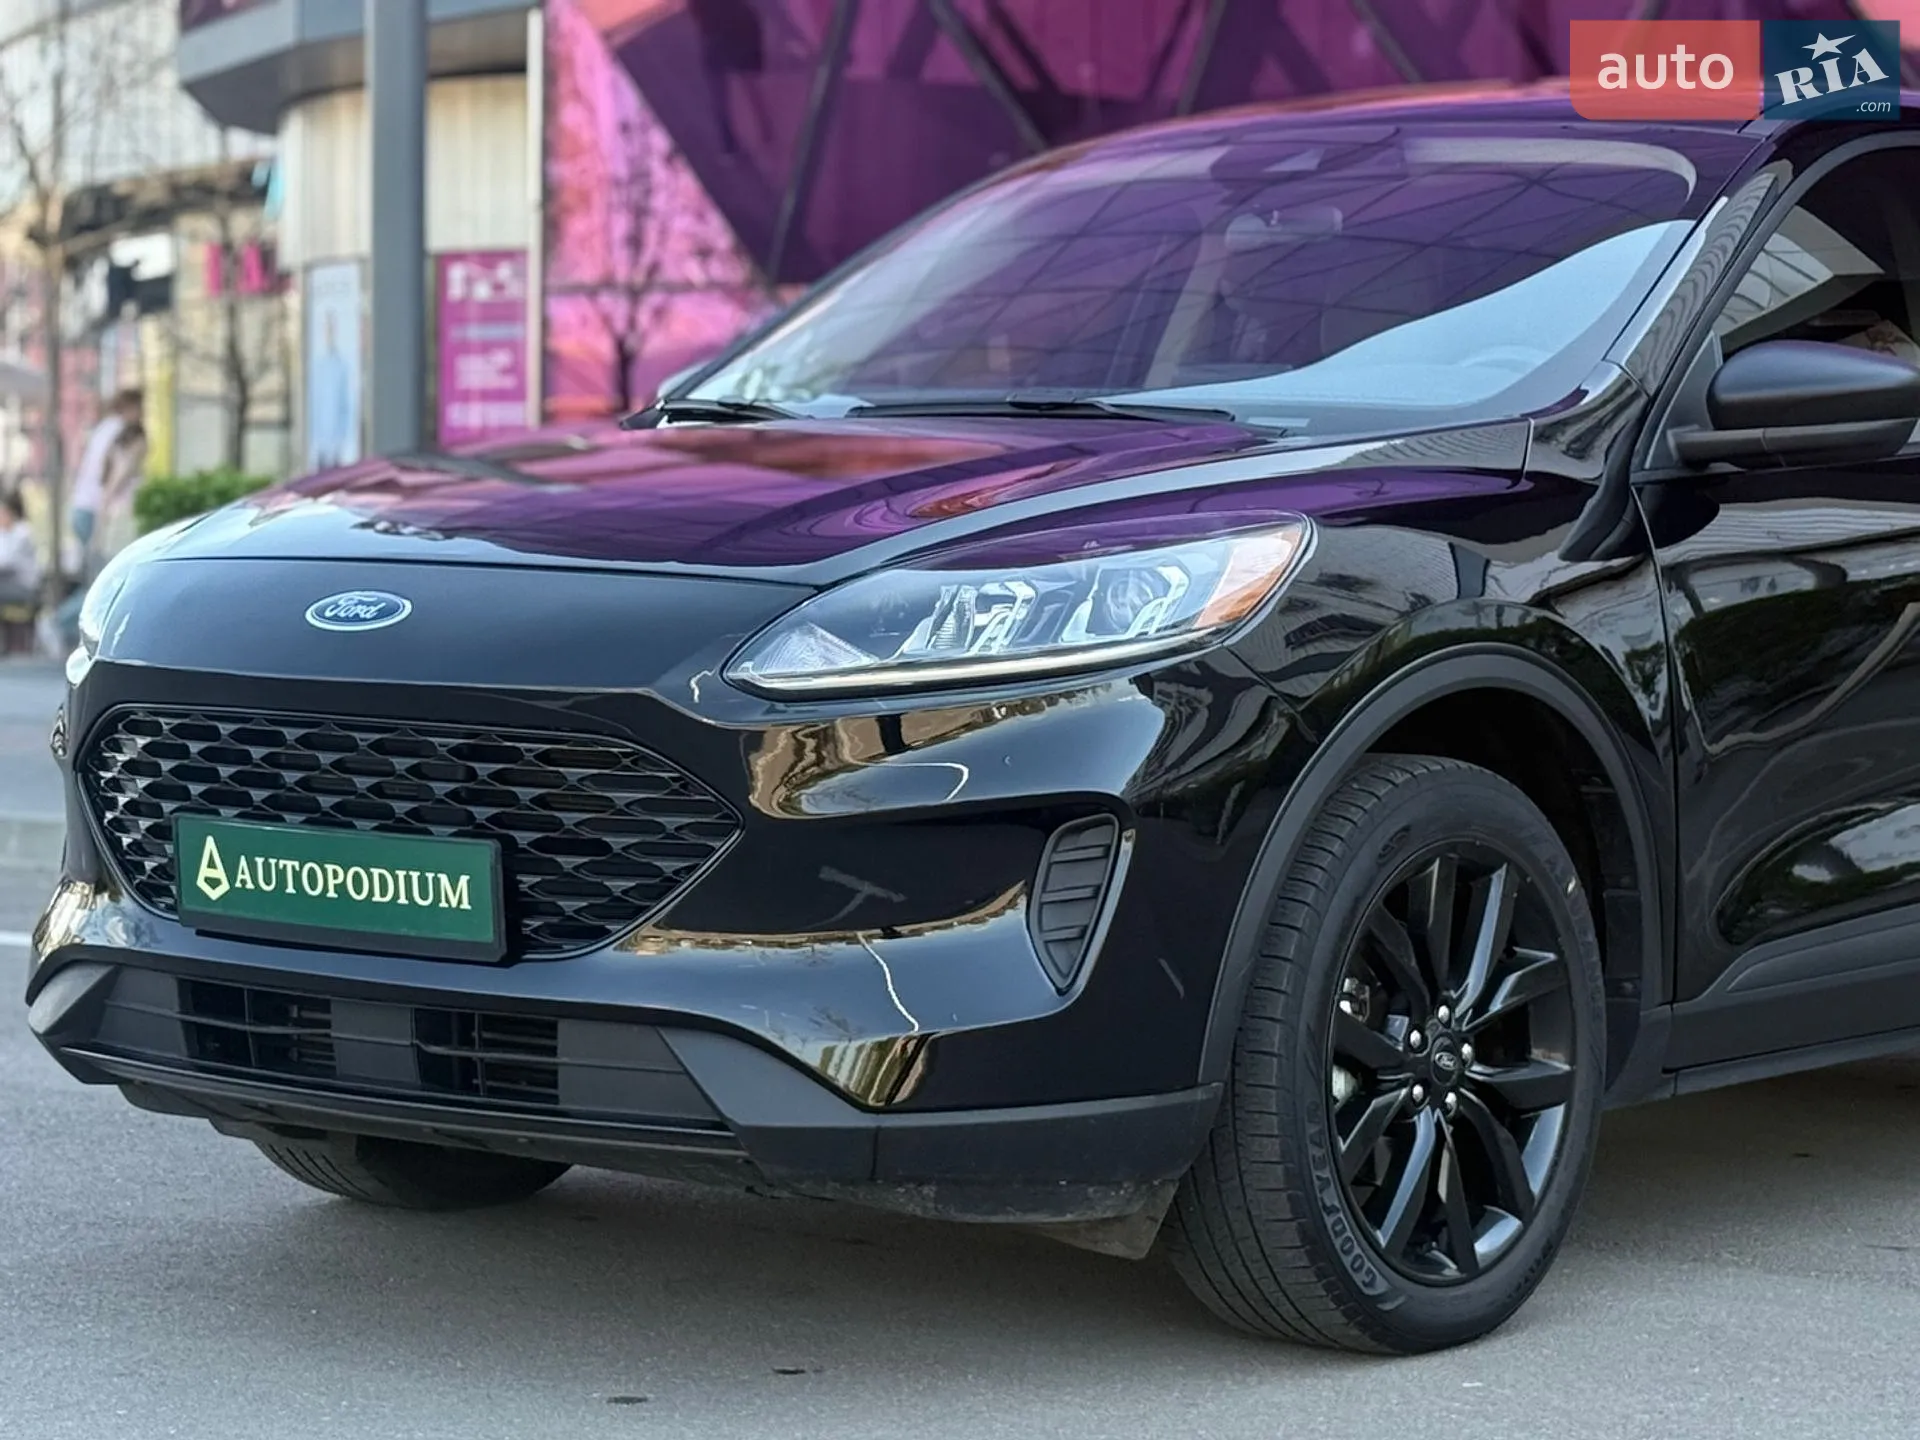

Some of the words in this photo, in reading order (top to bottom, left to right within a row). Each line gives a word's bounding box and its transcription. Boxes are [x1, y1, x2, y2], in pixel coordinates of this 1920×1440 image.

[324, 595, 386, 619] Ford
[235, 855, 472, 911] AUTOPODIUM
[1306, 1100, 1379, 1290] GOODYEAR
